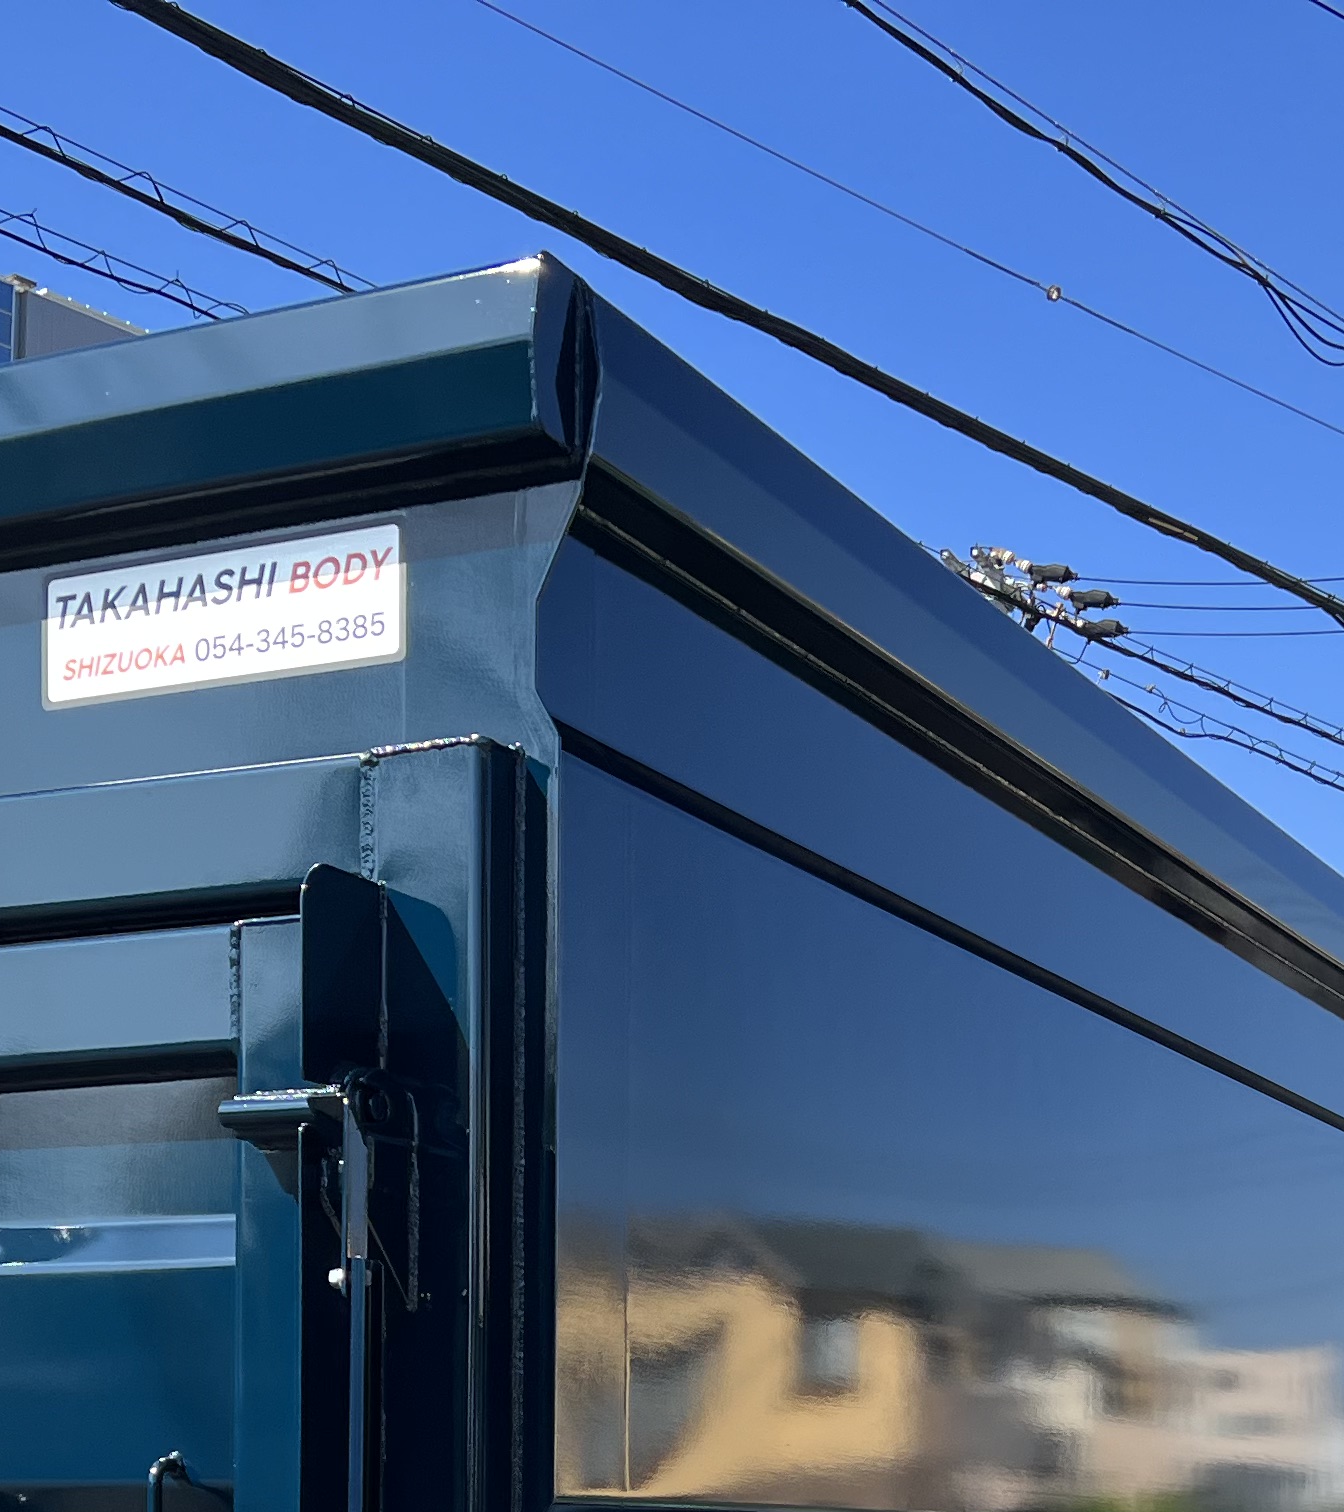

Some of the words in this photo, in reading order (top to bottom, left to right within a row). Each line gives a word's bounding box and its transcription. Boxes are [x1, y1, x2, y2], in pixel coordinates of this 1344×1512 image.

[55, 561, 278, 630] TAKAHASHI
[289, 546, 393, 594] BODY
[63, 643, 186, 681] SHIZUOKA
[195, 611, 386, 662] 054-345-8385
